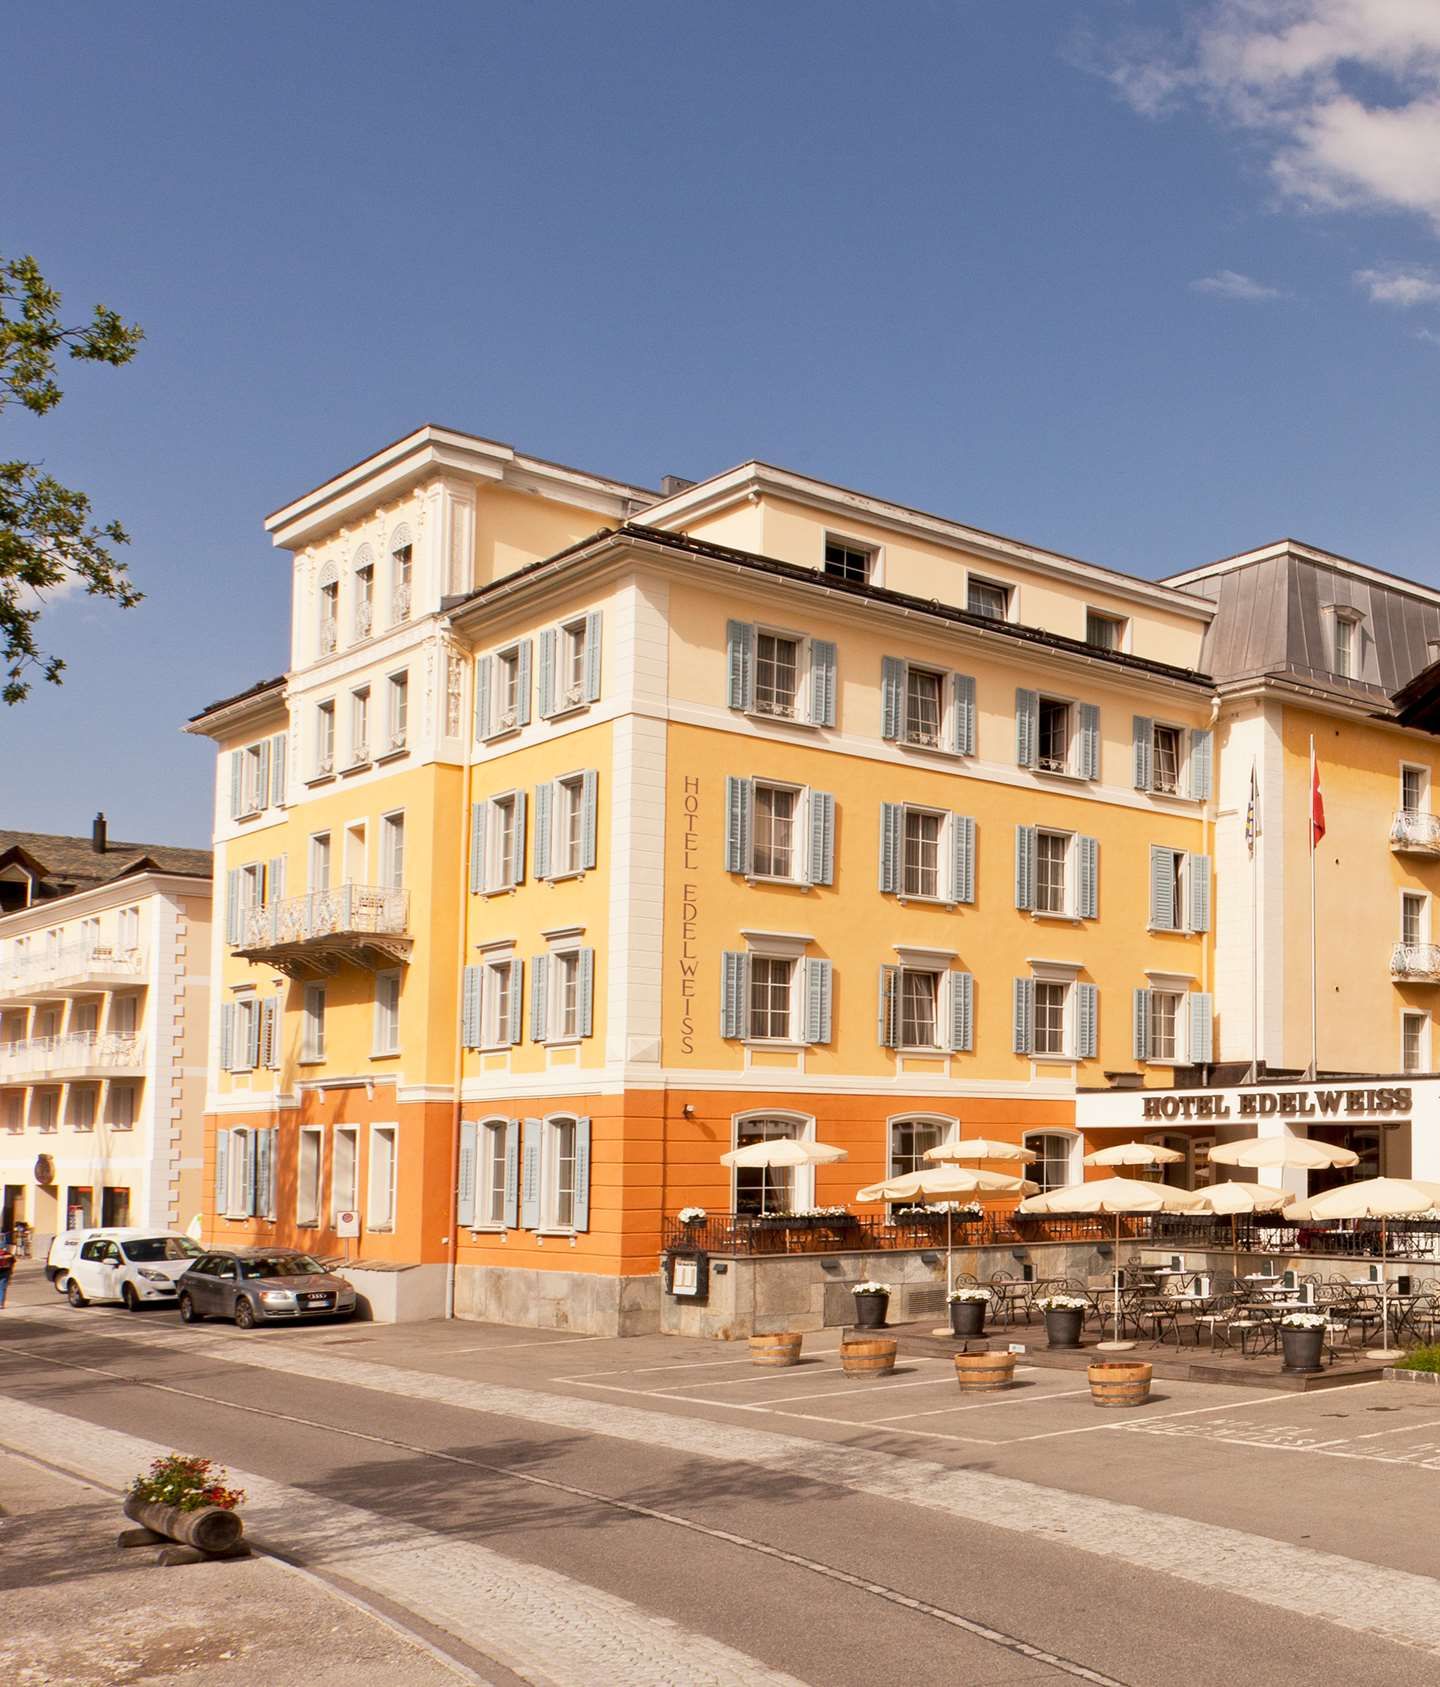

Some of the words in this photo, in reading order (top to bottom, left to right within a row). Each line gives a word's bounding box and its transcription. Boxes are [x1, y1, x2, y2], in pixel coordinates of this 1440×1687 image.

[684, 776, 699, 870] HOTEL
[680, 884, 699, 1054] EDELWEISS
[1142, 1094, 1230, 1118] HOTEL
[1237, 1088, 1413, 1115] EDELWEISS
